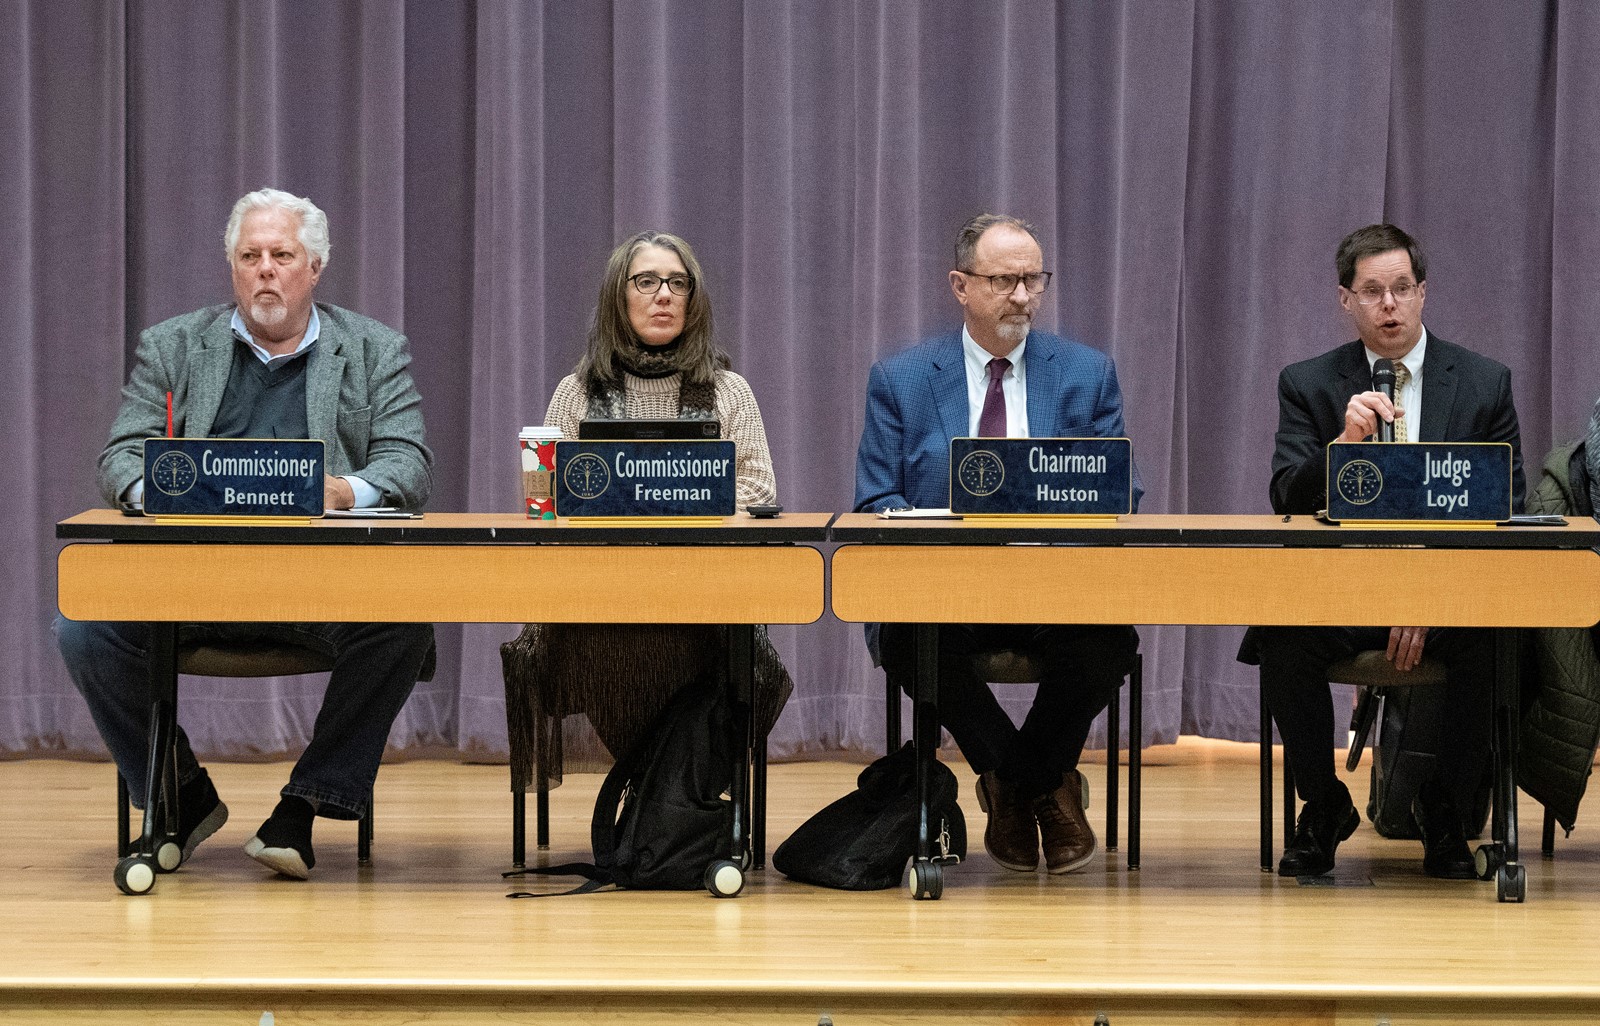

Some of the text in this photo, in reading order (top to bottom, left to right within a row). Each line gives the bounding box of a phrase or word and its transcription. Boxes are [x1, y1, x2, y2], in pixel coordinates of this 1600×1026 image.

[202, 450, 317, 477] Commissioner
[615, 451, 729, 478] Commissioner
[1029, 446, 1107, 474] Chairman
[1423, 452, 1471, 487] Judge
[224, 487, 295, 506] Bennett
[635, 484, 711, 501] Freeman
[1037, 484, 1098, 502] Huston
[1427, 489, 1469, 512] Loyd
